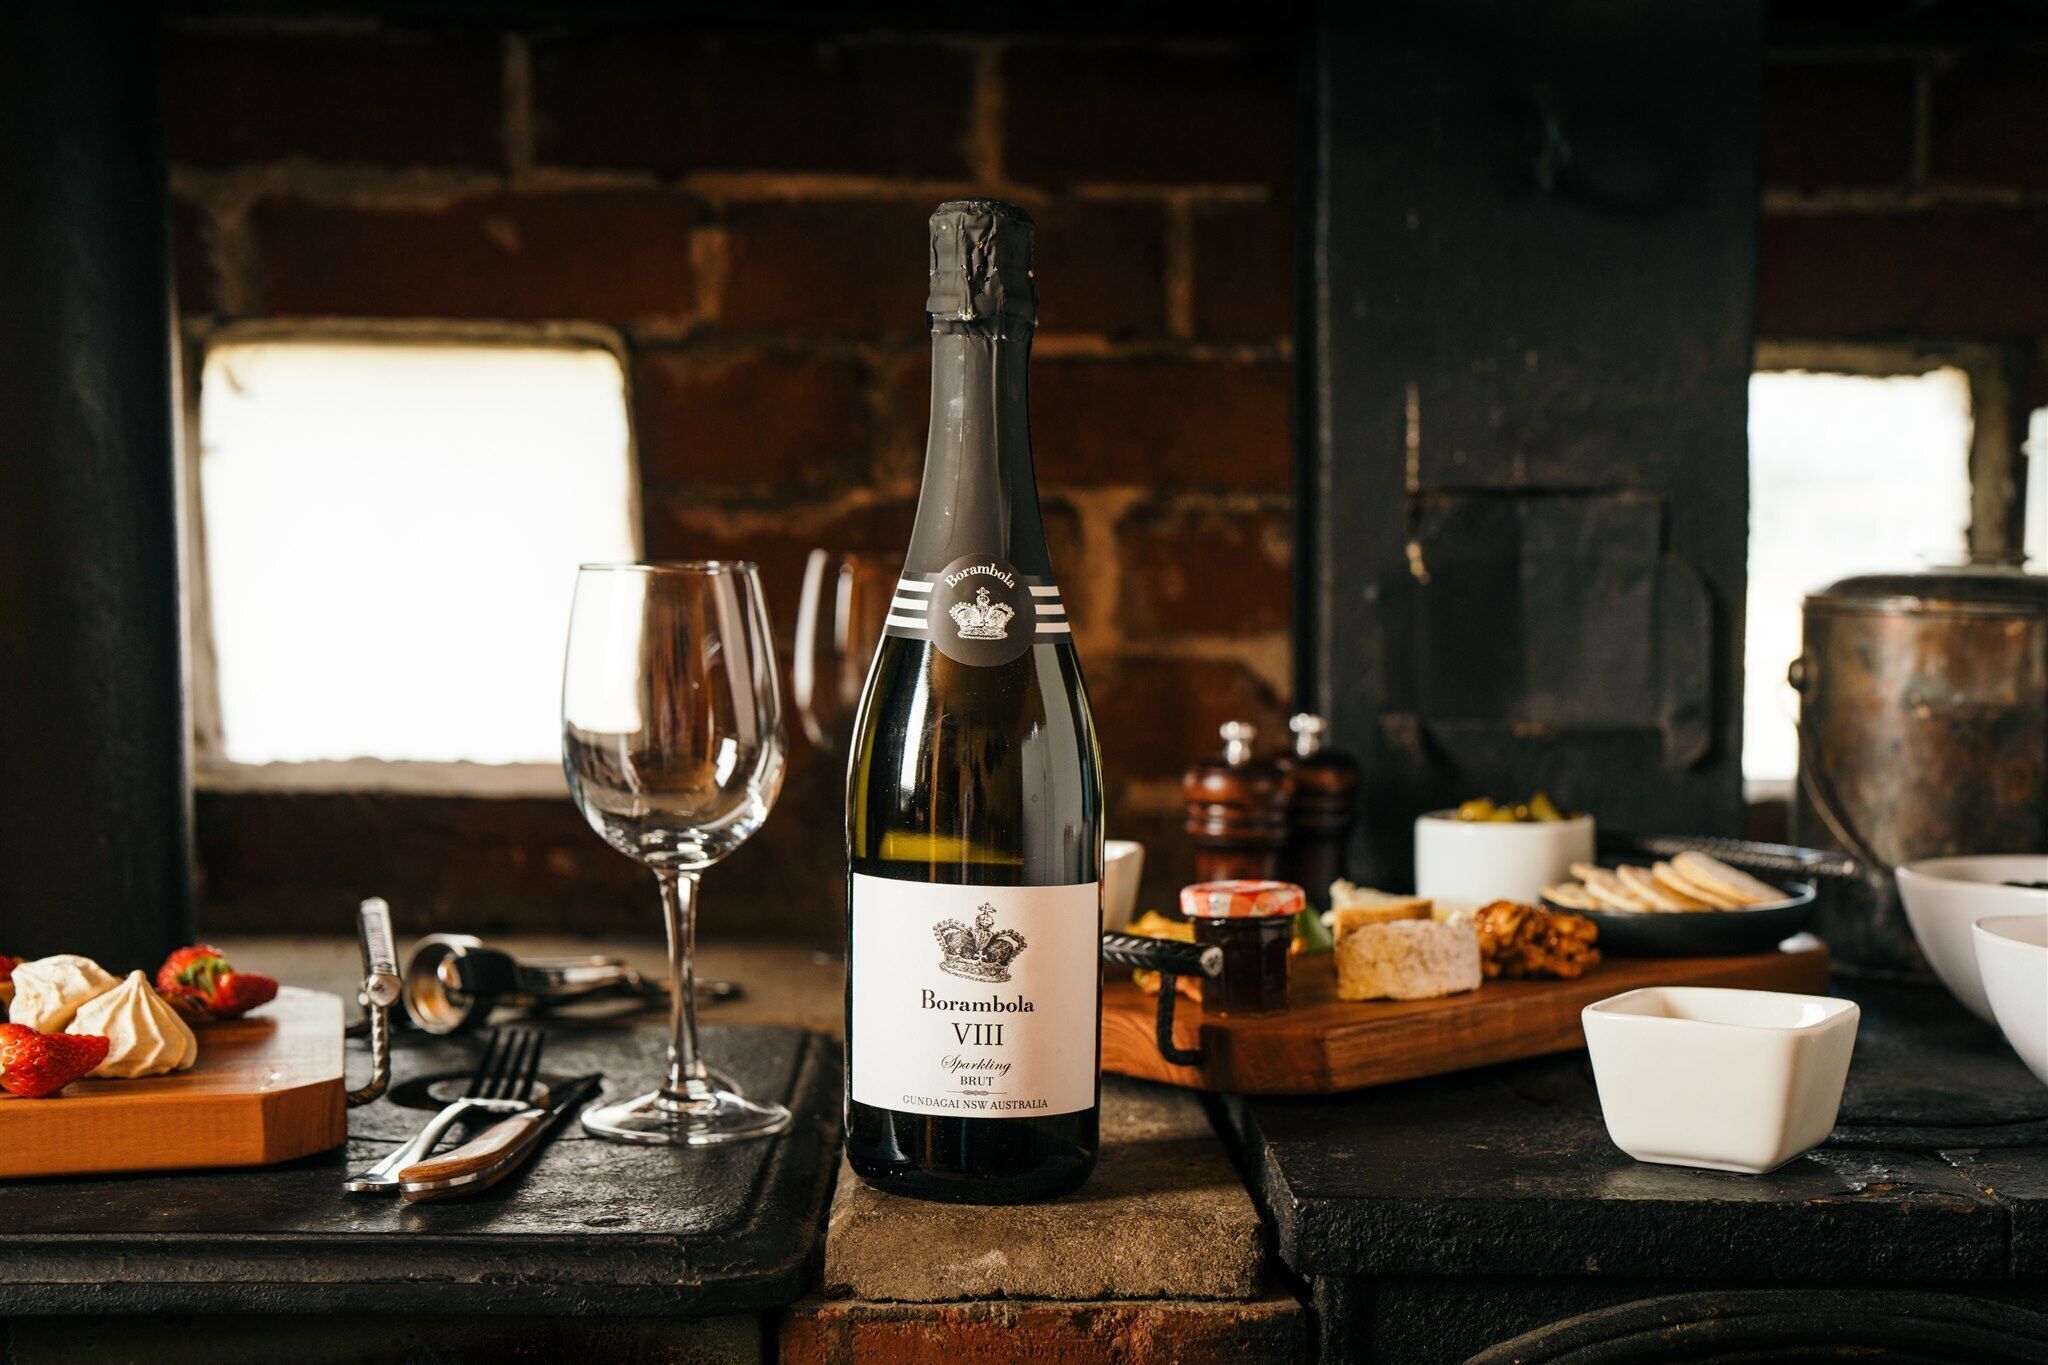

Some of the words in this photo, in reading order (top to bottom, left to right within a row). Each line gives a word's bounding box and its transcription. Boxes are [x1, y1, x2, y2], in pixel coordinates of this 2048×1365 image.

[944, 563, 1015, 589] Borambola
[921, 989, 1035, 1013] Borambola
[952, 1022, 1004, 1046] VIII
[941, 1055, 1012, 1076] Sparkling
[960, 1076, 995, 1086] BRUT
[902, 1095, 960, 1109] GUNDAGAI
[963, 1100, 987, 1110] NSW
[990, 1099, 1048, 1110] AUSTRALIA
